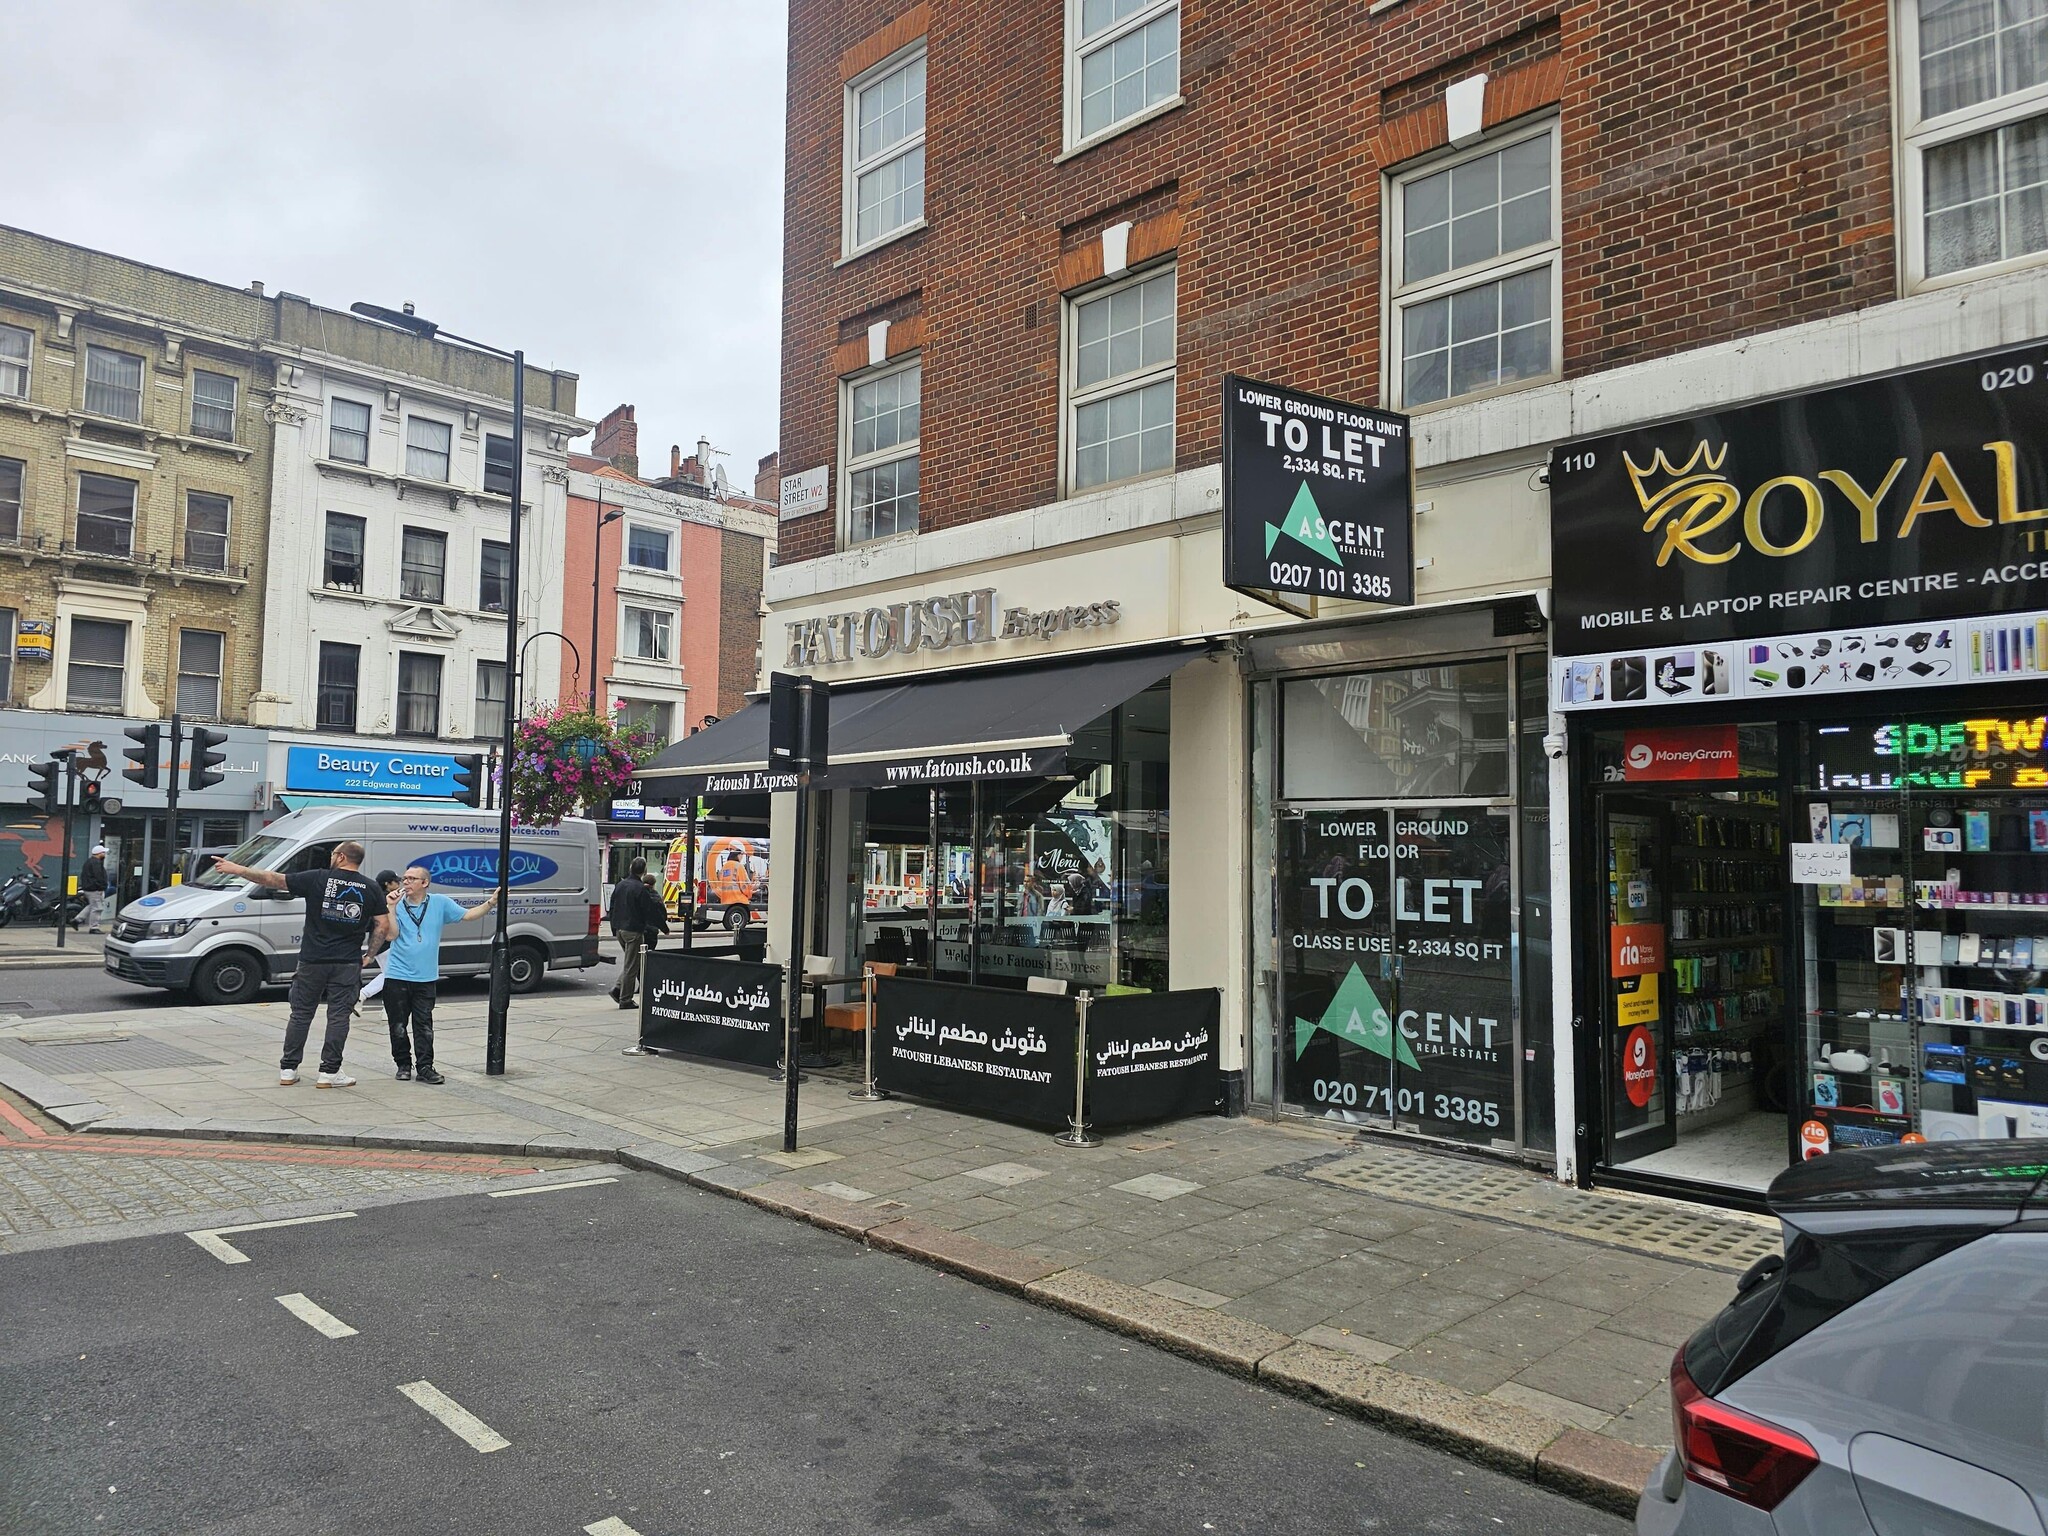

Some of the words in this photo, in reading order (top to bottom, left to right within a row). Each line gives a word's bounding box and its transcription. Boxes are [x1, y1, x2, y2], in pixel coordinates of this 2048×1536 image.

[1981, 364, 2034, 392] 020
[1239, 388, 1282, 411] LOWER
[1285, 399, 1334, 422] GROUND
[1337, 411, 1374, 431] FLOOR
[1376, 420, 1403, 438] UNIT
[1259, 411, 1308, 452] TO
[1322, 425, 1386, 468] LET
[1283, 455, 1319, 475] 2,334
[1322, 462, 1345, 480] SQ.
[1348, 467, 1366, 484] FT.
[1561, 451, 1596, 473] 110
[784, 477, 802, 492] STAR
[784, 488, 809, 505] STREET
[810, 485, 823, 498] W2
[1299, 515, 1385, 549] ASCENT
[1340, 544, 1357, 555] REAL
[1360, 547, 1385, 558] ESTATE
[1270, 561, 1312, 588] 0207
[1318, 567, 1345, 592] 101
[1352, 572, 1391, 598] 3385
[1581, 607, 1654, 630] MOBILE
[1659, 605, 1674, 621] &
[1679, 594, 1763, 619] LAPTOP
[1768, 584, 1851, 609] REPAIR
[1858, 572, 1958, 599] CENTRE
[783, 587, 997, 668] FATOUSH
[999, 599, 1122, 641] Express
[318, 753, 380, 777] Beauty
[388, 758, 449, 777] Center
[886, 752, 1032, 780] www.fatoush.co.uk
[1655, 748, 1732, 762] MoneyGram
[345, 779, 361, 787] 222
[362, 780, 399, 790] Edgware
[400, 782, 421, 790] Road
[705, 773, 750, 792] Fatoush
[753, 772, 798, 792] Express
[408, 823, 560, 836] www.aquaflowsvices.com
[1320, 821, 1377, 837] LOWER
[1395, 820, 1469, 836] GROUND
[1039, 848, 1081, 874] Menu
[1359, 844, 1419, 859] FLOOR
[330, 883, 338, 898] STOP
[333, 879, 367, 889] EXPLORING
[439, 875, 473, 884] Services
[454, 898, 486, 906] Drainag
[1310, 877, 1374, 920] TO
[1395, 878, 1483, 924] LET
[1630, 892, 1645, 903] OPEN
[531, 907, 558, 915] Surveys
[1292, 934, 1342, 951] CLASS
[1345, 936, 1355, 950] E
[1358, 937, 1390, 952] USE
[1408, 938, 1451, 957] 2,334
[1454, 941, 1479, 961] SQ
[1483, 943, 1503, 960] FT
[1620, 935, 1639, 966] ria
[993, 955, 1004, 966] to
[651, 1006, 680, 1020] FATOUSH
[680, 1011, 721, 1025] LEBANESE
[721, 1016, 770, 1032] RESTAURANT
[895, 1015, 936, 1041] لبناني
[1345, 1006, 1498, 1049] ASCENT
[939, 1023, 988, 1046] مطعم
[1416, 1042, 1445, 1056] REAL
[1452, 1047, 1498, 1062] ESTATE
[892, 1046, 932, 1064] FATOUSH
[933, 1054, 984, 1073] LEBANESE
[985, 1063, 1052, 1084] RESTAURANT
[1096, 1064, 1130, 1078] FATOUSH
[1130, 1060, 1169, 1073] LEBANESE
[1169, 1053, 1209, 1069] RESTAURANT
[1625, 1068, 1654, 1082] MoneyGram
[1313, 1078, 1357, 1107] 020
[1363, 1085, 1425, 1115] 7101
[1434, 1094, 1500, 1128] 3385
[1804, 1123, 1825, 1137] ria
